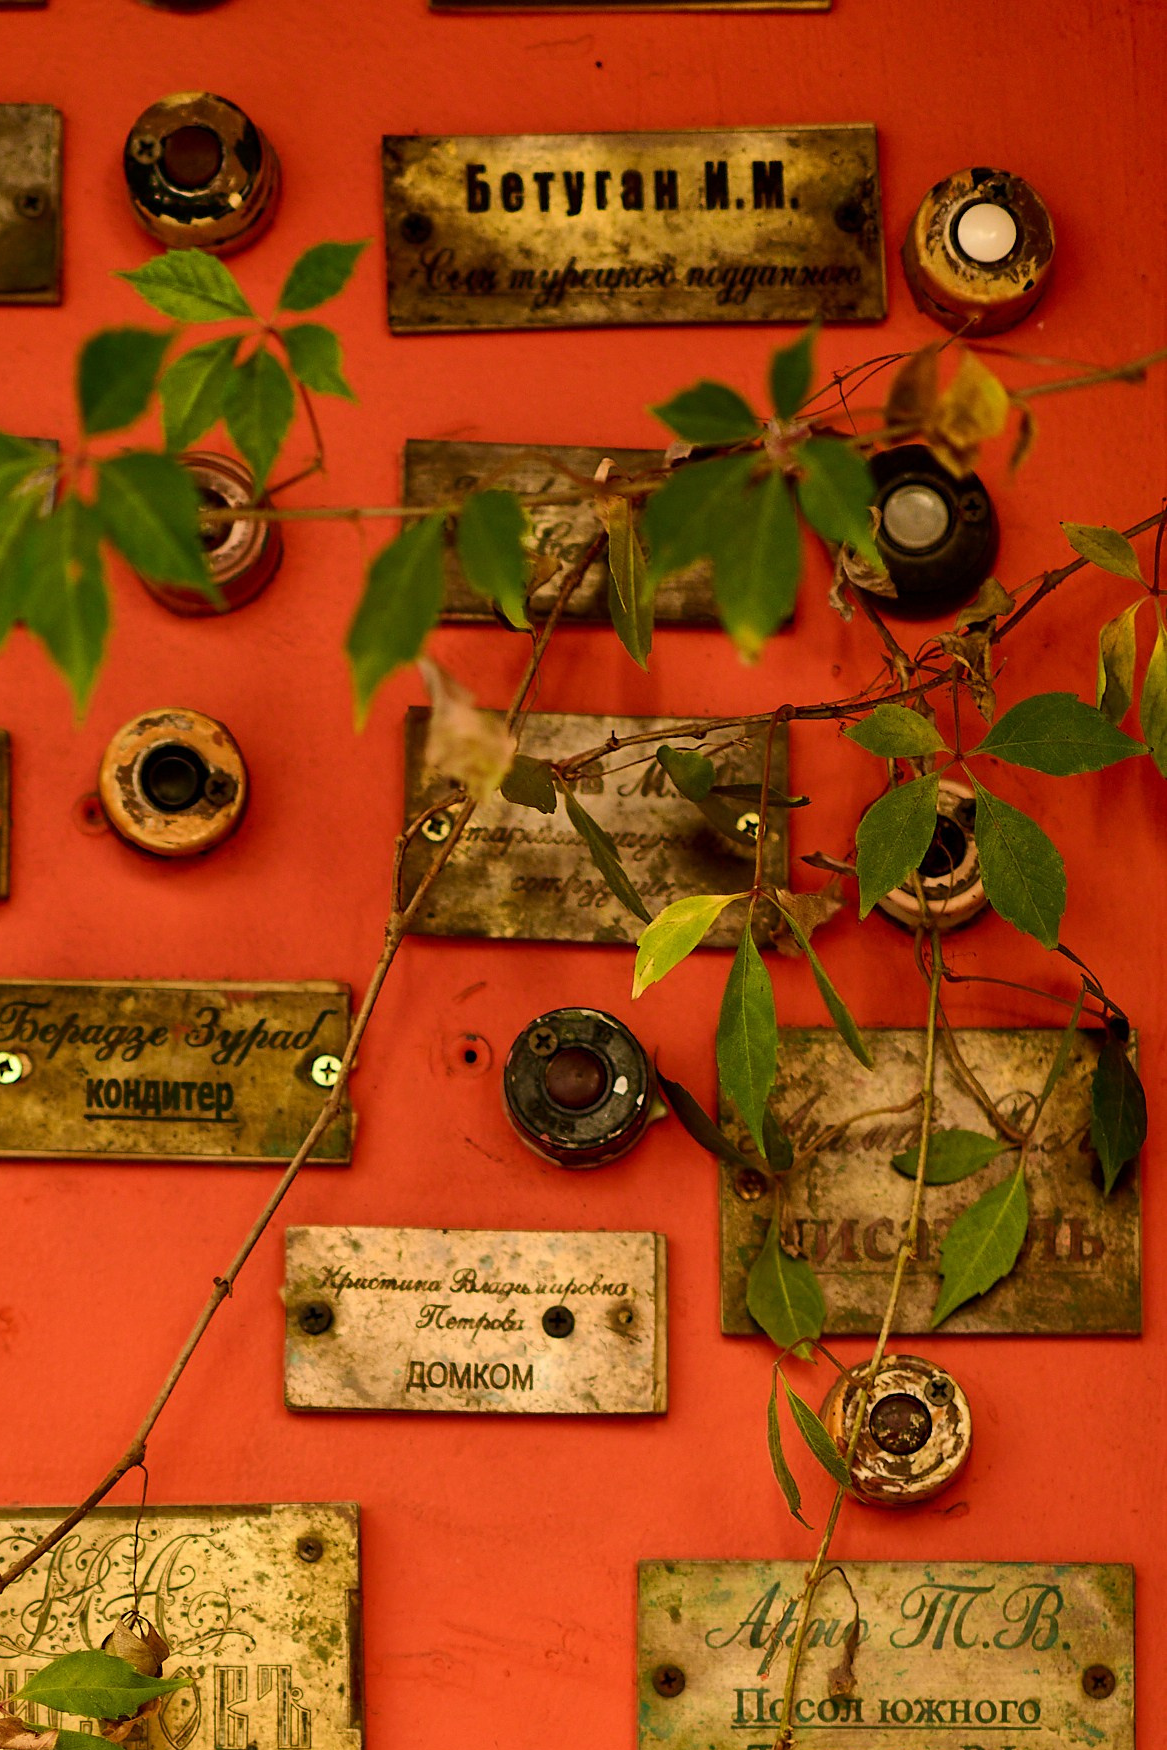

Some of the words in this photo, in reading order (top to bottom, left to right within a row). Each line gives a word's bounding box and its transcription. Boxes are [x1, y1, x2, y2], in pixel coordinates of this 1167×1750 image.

[466, 163, 680, 217] Бетуган
[705, 160, 800, 211] И.М.
[414, 247, 496, 291] Сын
[510, 258, 675, 311] турецкого
[687, 261, 862, 306] подданного
[184, 1005, 338, 1067] Зураб
[86, 1076, 234, 1119] кондитер
[319, 1264, 442, 1298] Кристина
[415, 1303, 524, 1343] Петрова
[406, 1360, 535, 1392] ДОМКОМ
[889, 1582, 1072, 1651] Т.В.
[734, 1687, 865, 1725] Посол
[877, 1695, 1042, 1725] южного
